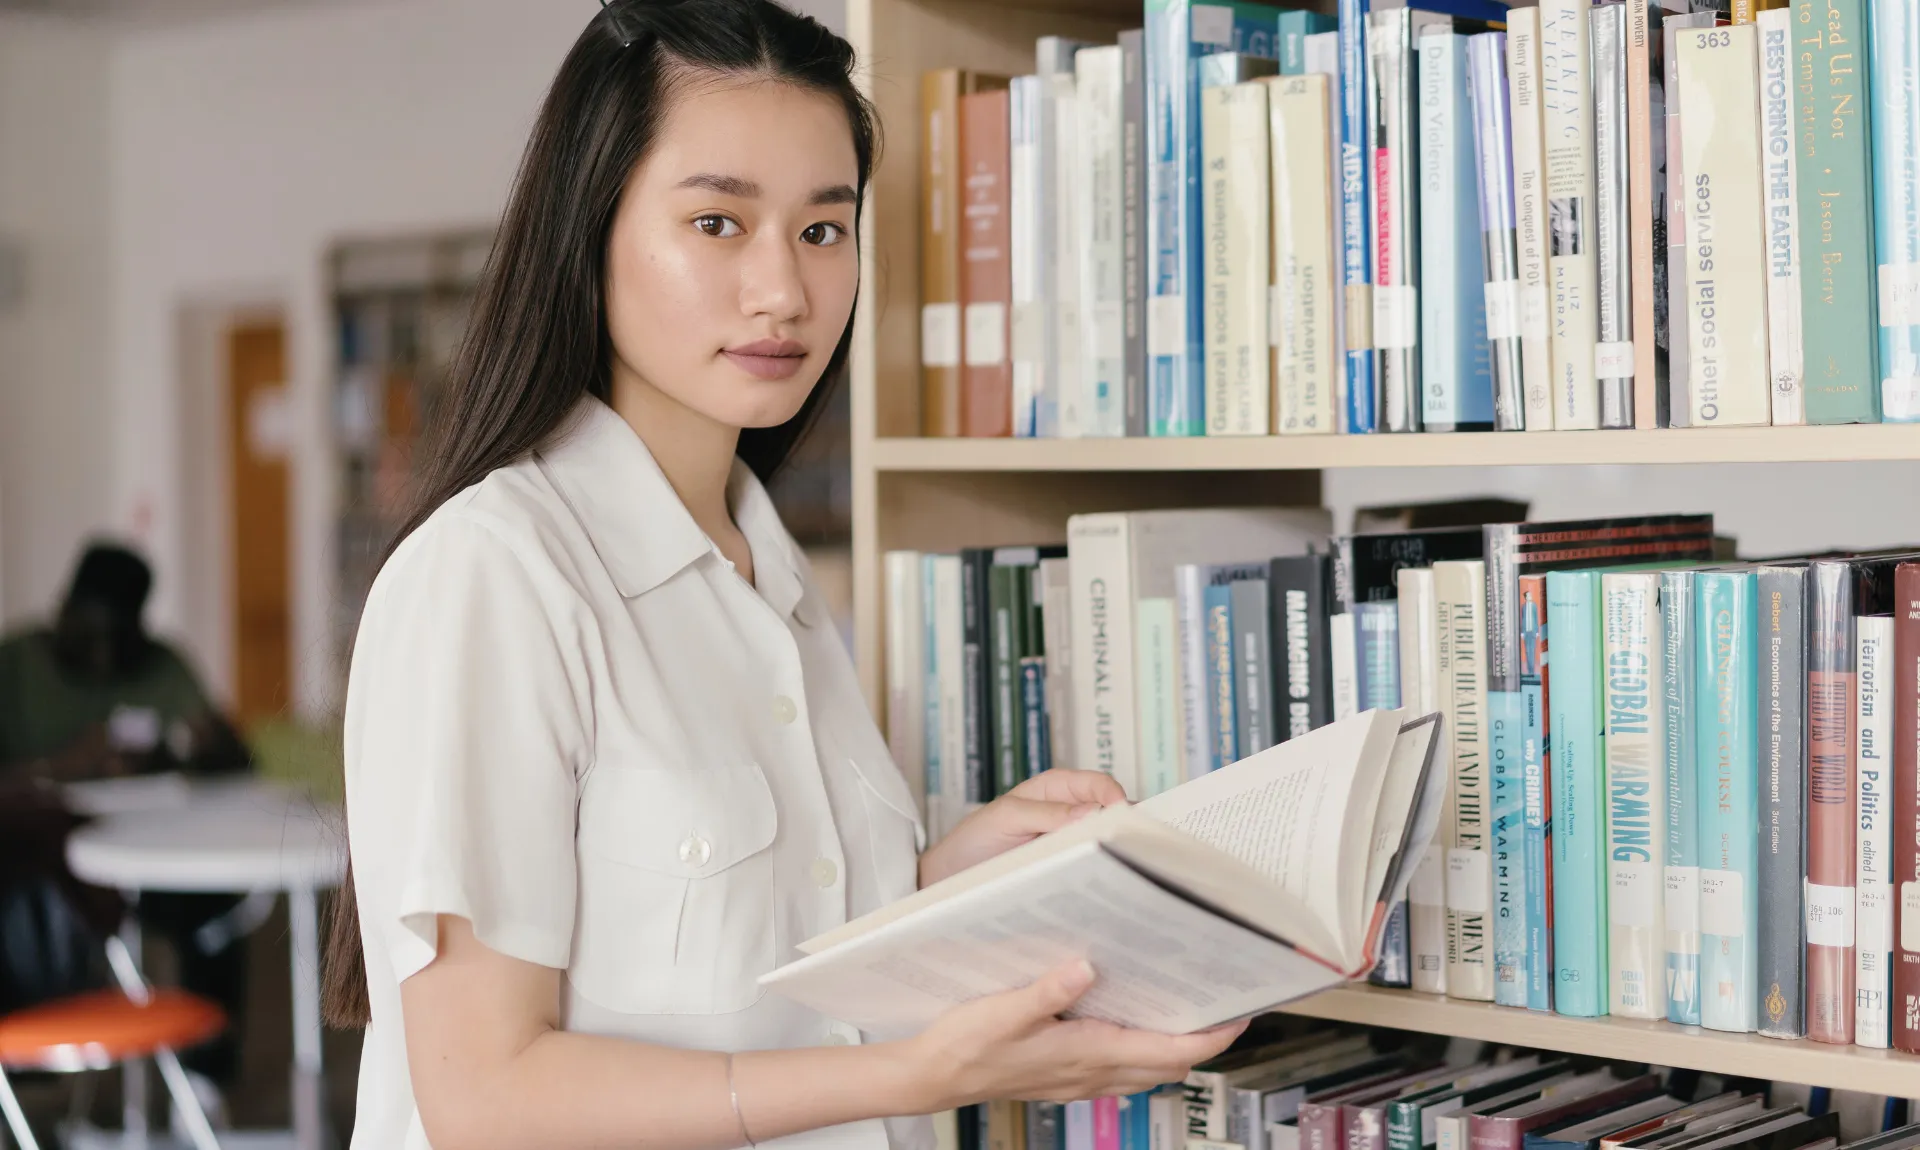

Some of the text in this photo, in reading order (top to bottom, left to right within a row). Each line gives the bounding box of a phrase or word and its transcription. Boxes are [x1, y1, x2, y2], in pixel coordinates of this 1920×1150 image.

[1635, 15, 1645, 48] POVERTY
[1697, 31, 1731, 49] 363
[1515, 34, 1533, 107] Henry Hazlitt
[1544, 17, 1559, 113] NIGHT
[1800, 4, 1823, 158] to Temptation
[1830, 53, 1853, 86] Us
[1425, 46, 1445, 193] Dating Violence
[1831, 94, 1854, 139] Not
[1522, 170, 1536, 190] The
[1766, 29, 1791, 278] RESTORING THE EARTH
[1210, 179, 1230, 277] problems
[1522, 194, 1537, 243] Conquest
[1818, 188, 1843, 305] Jason Berry
[1525, 247, 1539, 259] of
[1211, 283, 1228, 345] social
[1556, 267, 1566, 338] MURRAY
[1569, 286, 1580, 310] LIZ
[1693, 173, 1719, 421] Other social services
[1300, 265, 1317, 429] & its alleviation
[1601, 355, 1623, 367] REF
[1212, 350, 1229, 432] General
[1235, 345, 1251, 431] services
[1453, 603, 1476, 662] PUBLIC
[1666, 603, 1680, 627] The
[1286, 590, 1309, 699] MANAGING
[1664, 631, 1681, 684] Shaping
[1089, 577, 1114, 776] CRIMINAL JUSTI
[1666, 688, 1681, 704] of
[1861, 637, 1880, 717] Terrorism
[1456, 672, 1479, 743] HEALTH
[1717, 609, 1732, 815] CHANGING COURSE
[1771, 591, 1782, 854] Siebert Economics of the Environment 3rd Edition
[1457, 749, 1480, 788] AND
[1525, 739, 1537, 762] why
[1566, 741, 1575, 768] Scaling
[1609, 650, 1651, 863] GLOBAL WARMING
[1668, 705, 1682, 826] Environmentalism
[1861, 728, 1880, 759] and
[1526, 764, 1541, 827] CRIME?
[1567, 784, 1576, 811] Scaling
[1811, 754, 1847, 805] WORLD
[1860, 770, 1880, 831] Politics
[1458, 792, 1482, 828] THE
[1494, 719, 1510, 919] GLOBAL WARMING
[1567, 813, 1576, 836] Down
[1670, 830, 1682, 844] in
[1862, 840, 1877, 873] edited
[1810, 905, 1843, 916] 364.106
[1810, 913, 1823, 922] STE
[1862, 950, 1875, 972] BIN
